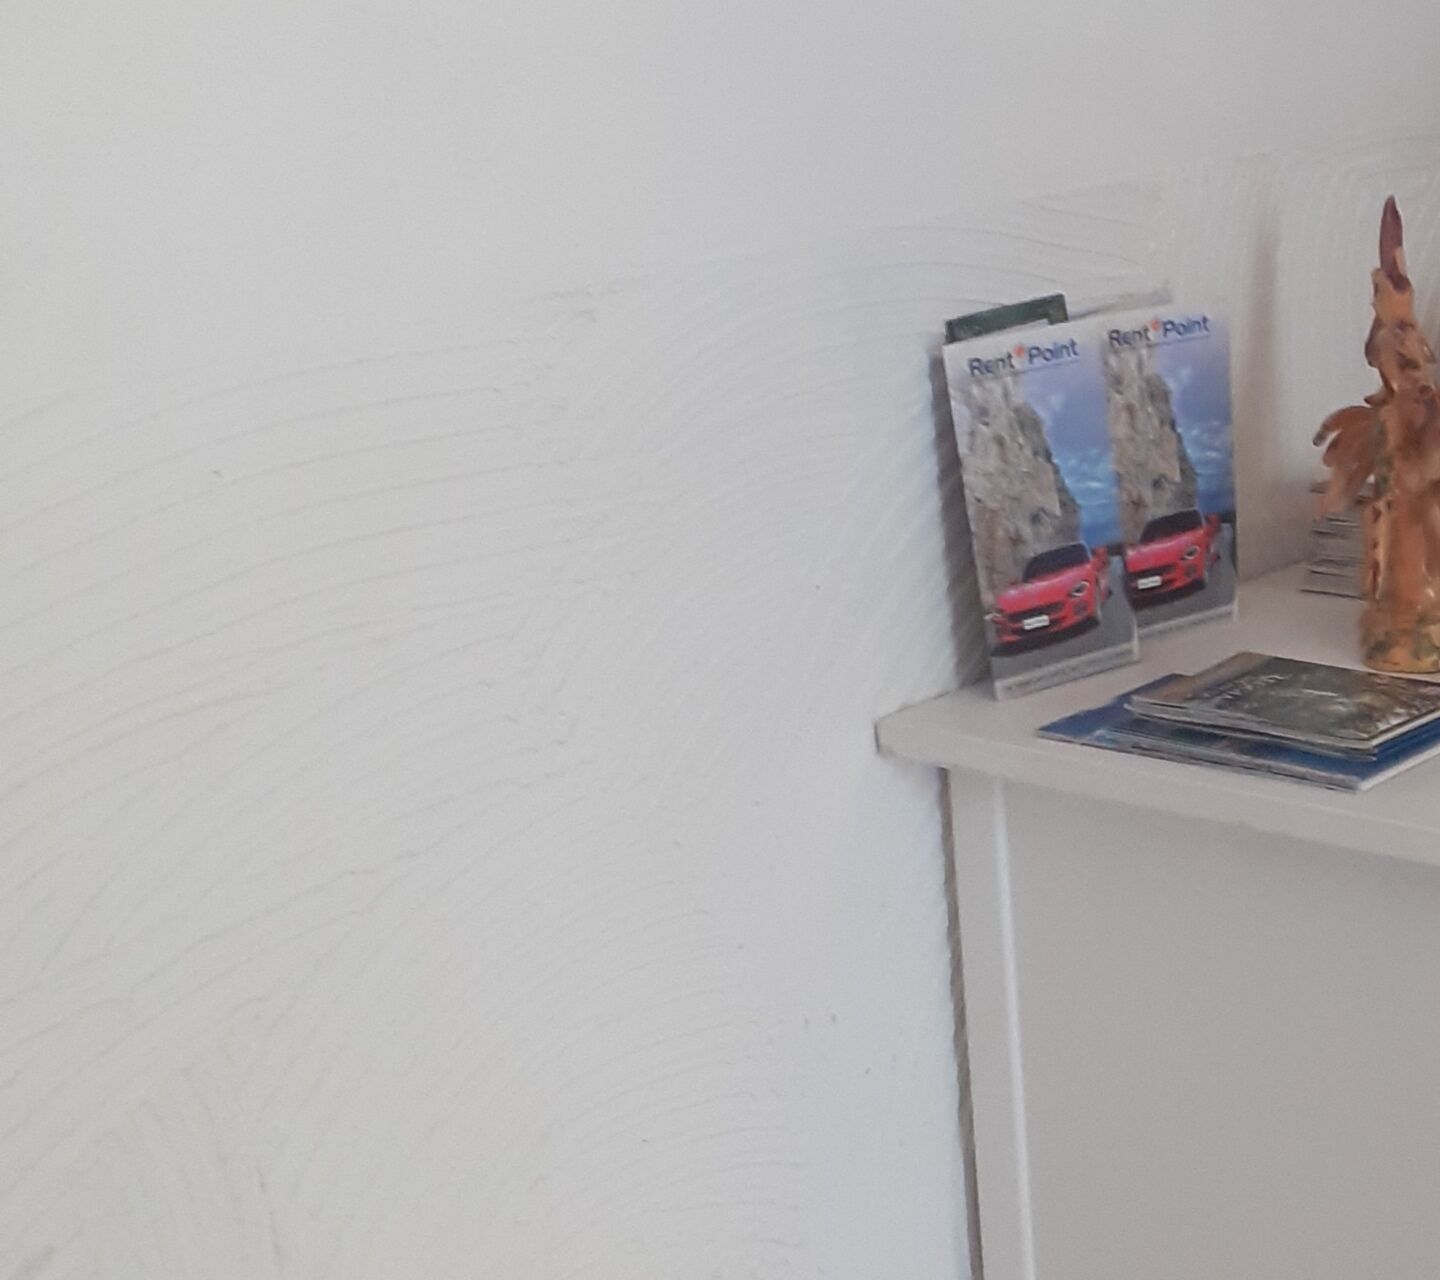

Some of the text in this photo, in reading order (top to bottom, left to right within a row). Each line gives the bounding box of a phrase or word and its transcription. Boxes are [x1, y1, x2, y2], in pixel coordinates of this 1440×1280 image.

[1108, 314, 1211, 348] Rent Point
[968, 337, 1080, 377] Rent Point
